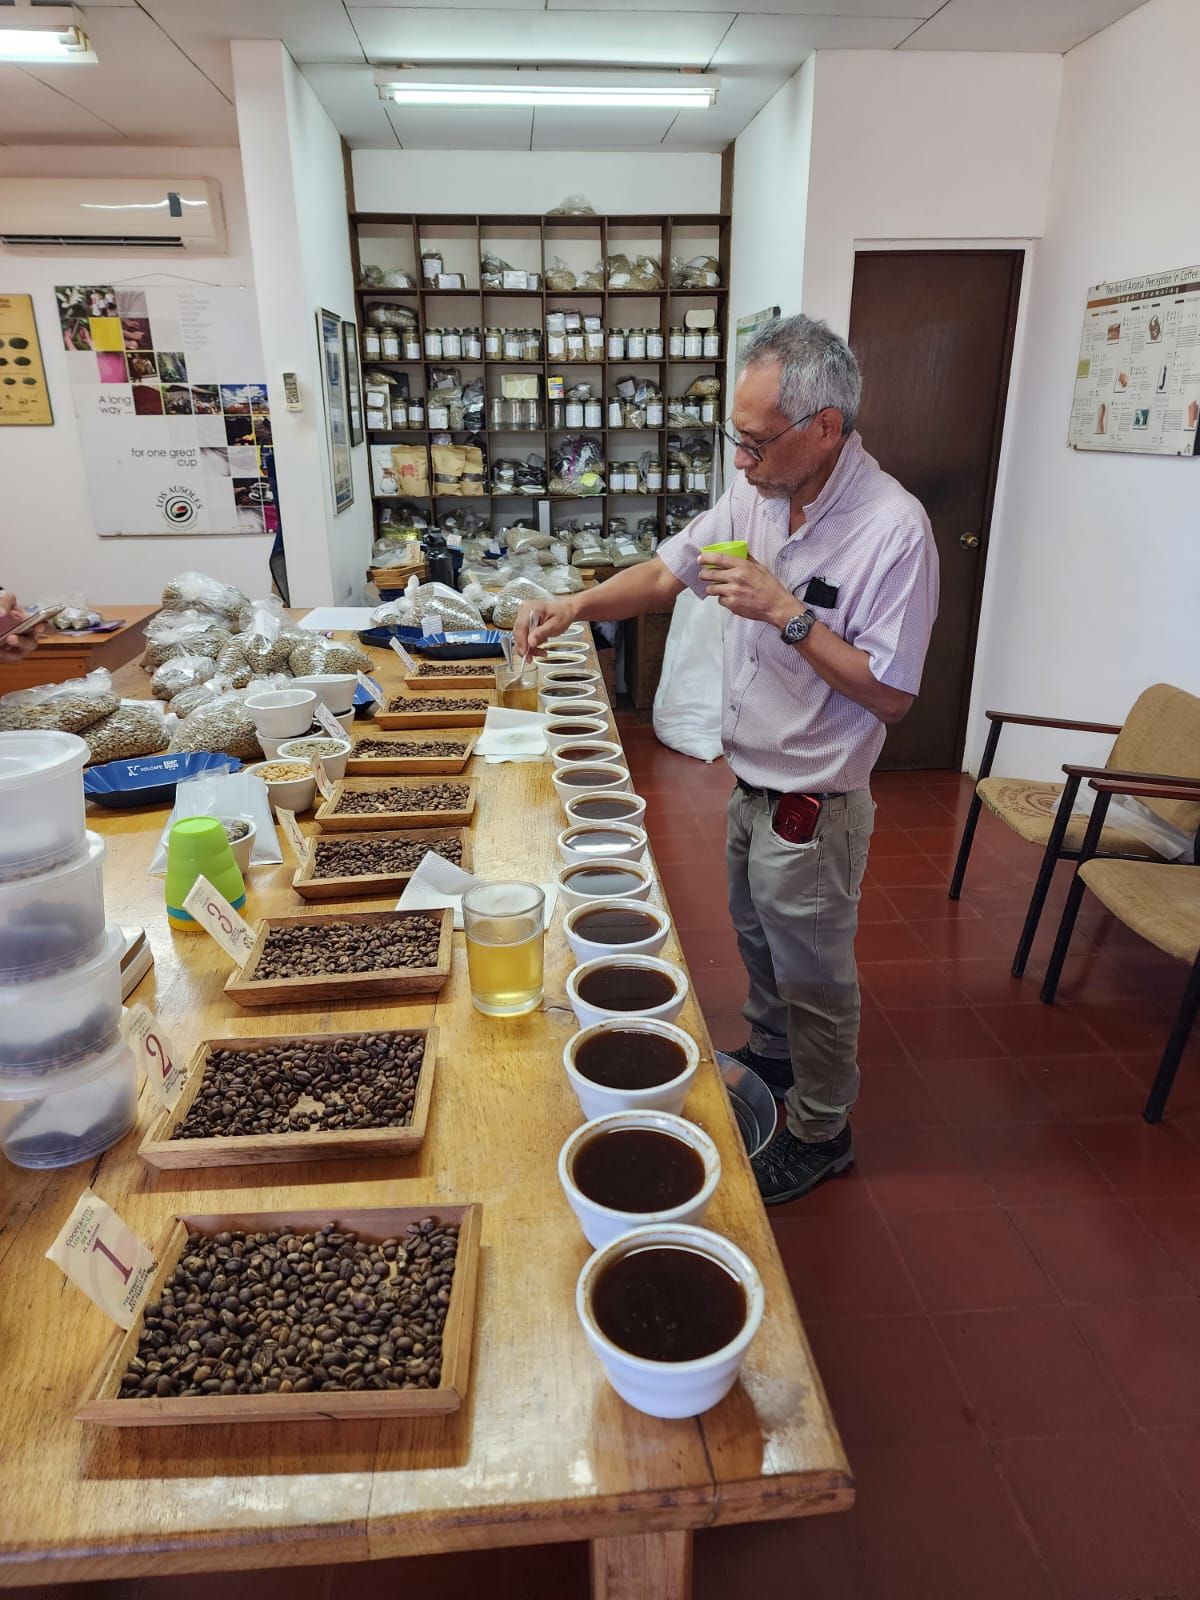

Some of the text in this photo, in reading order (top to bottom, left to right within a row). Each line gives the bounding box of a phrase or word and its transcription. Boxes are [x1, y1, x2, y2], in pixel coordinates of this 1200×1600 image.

[1105, 285, 1113, 295] The
[1122, 283, 1128, 292] of
[1128, 280, 1144, 290] Aroma
[1145, 274, 1172, 287] Perception
[1180, 268, 1199, 281] Coffee
[99, 395, 132, 406] A long
[100, 406, 121, 415] way
[131, 448, 196, 459] for one great
[177, 459, 198, 467] cup
[156, 484, 203, 510] LOS AUSOLES
[207, 903, 232, 934] 3
[145, 1033, 173, 1078] 2
[92, 1237, 134, 1285] 1
